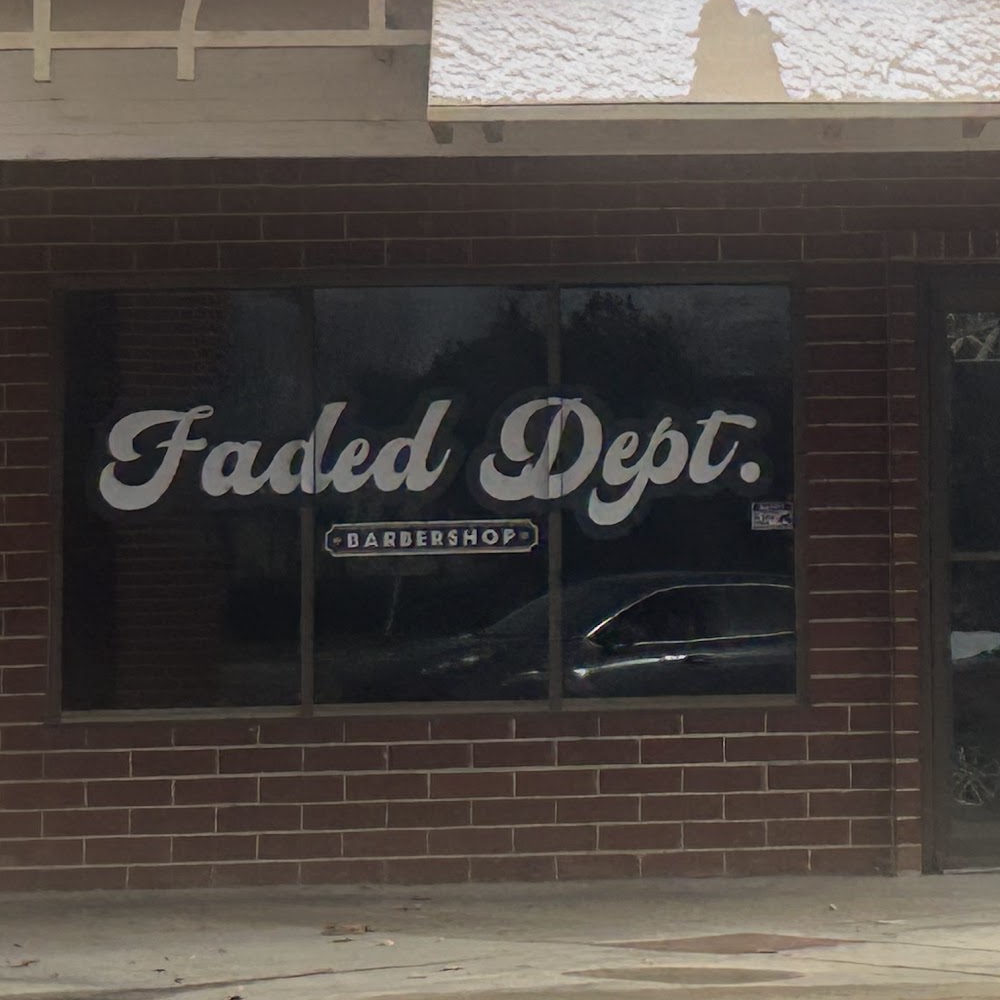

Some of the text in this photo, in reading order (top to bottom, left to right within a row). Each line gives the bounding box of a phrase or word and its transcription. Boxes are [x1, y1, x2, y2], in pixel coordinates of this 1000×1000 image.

[99, 397, 761, 526] Faded Dept.
[346, 528, 516, 549] BARBERSHOP
